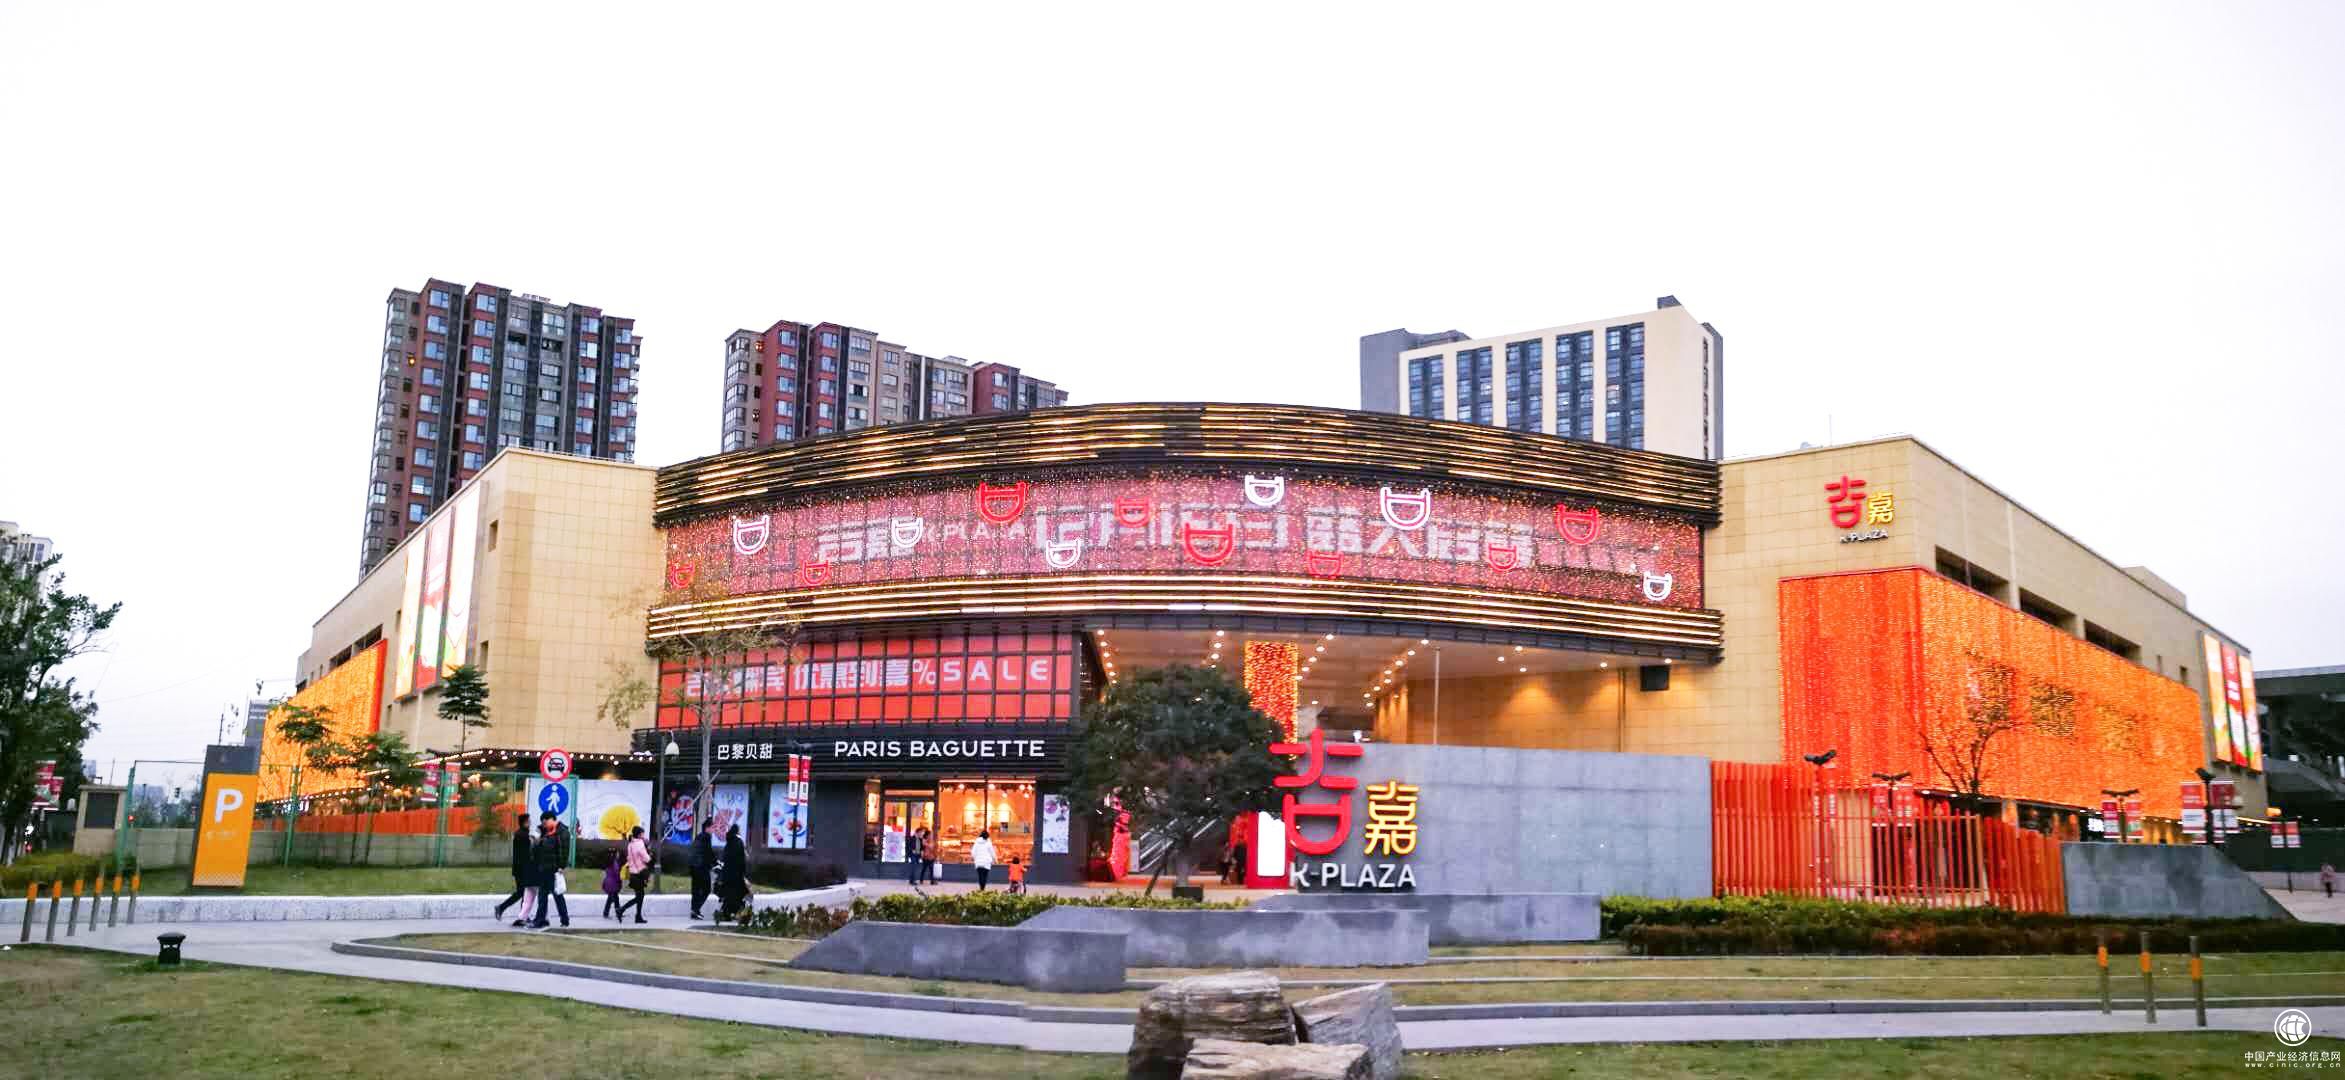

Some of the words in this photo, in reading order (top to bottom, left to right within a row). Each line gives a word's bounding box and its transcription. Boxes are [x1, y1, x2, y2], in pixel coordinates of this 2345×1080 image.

[1824, 475, 1895, 528] 吉嘉
[943, 659, 1050, 682] SALE
[717, 743, 773, 760] 巴黎贝甜
[834, 740, 902, 757] PARIS
[910, 740, 1045, 757] BAGUETTE
[1268, 727, 1421, 856] 吉嘉
[214, 787, 244, 824] P
[1290, 862, 1417, 889] K-PLAZA
